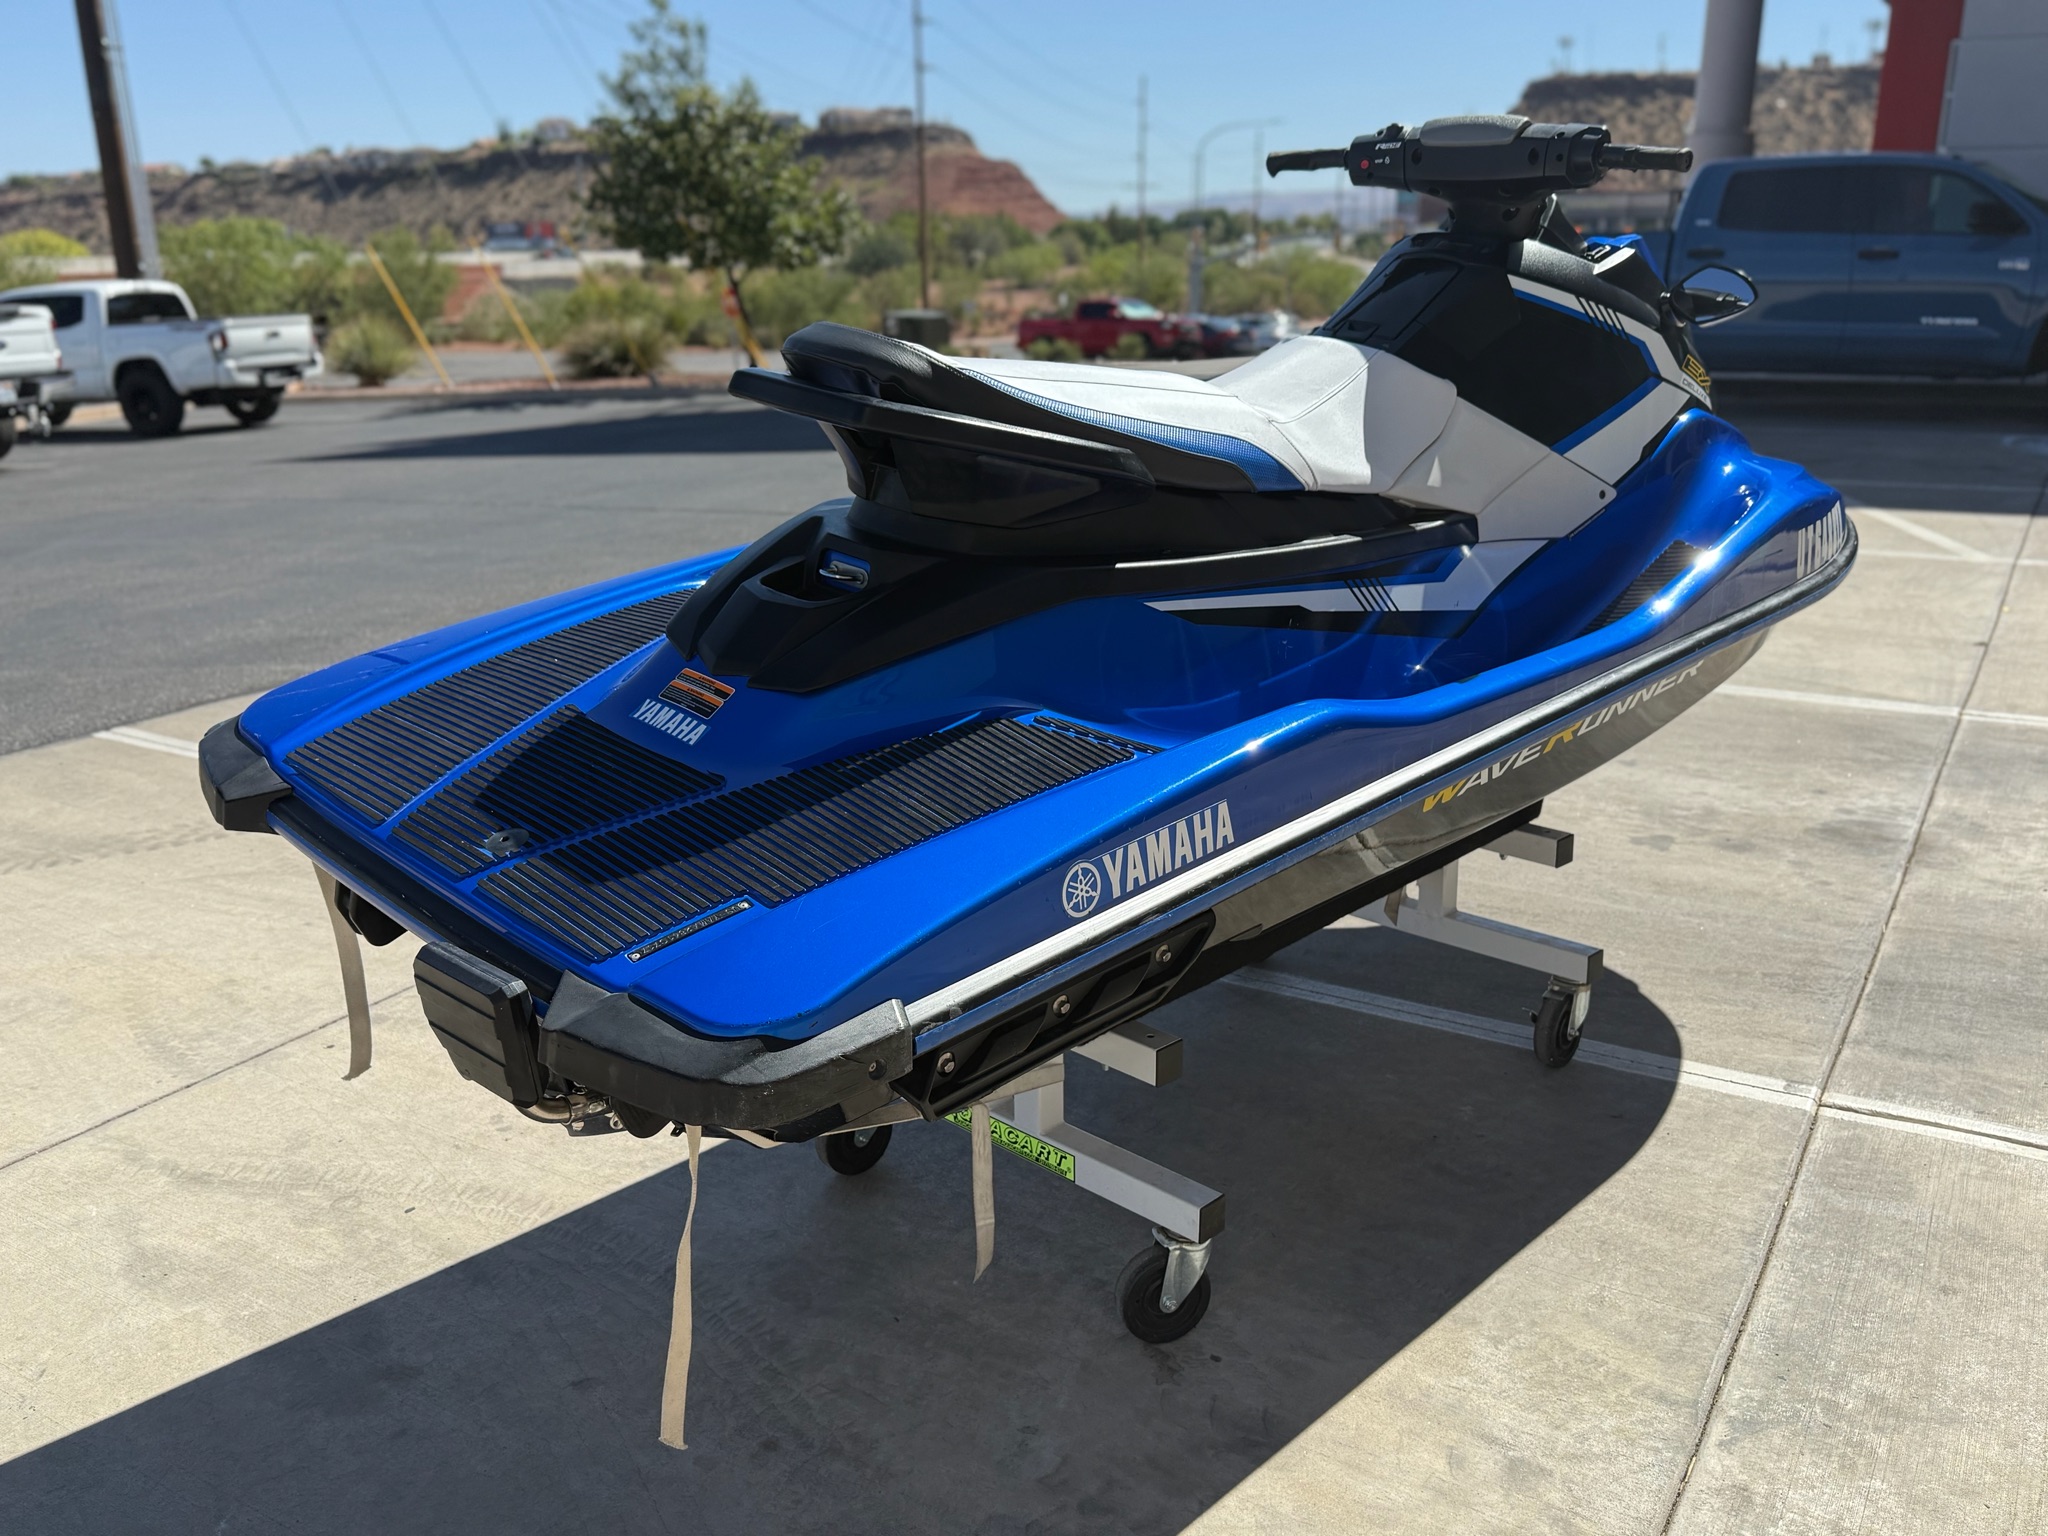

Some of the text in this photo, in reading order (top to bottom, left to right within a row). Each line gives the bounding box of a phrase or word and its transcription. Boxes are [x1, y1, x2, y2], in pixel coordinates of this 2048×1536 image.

[1682, 354, 1711, 394] EX
[1682, 378, 1708, 402] DELUXE
[633, 699, 708, 746] YAMAHA
[1422, 660, 1704, 813] WAVERUNNER
[1102, 801, 1235, 899] YAMAHA
